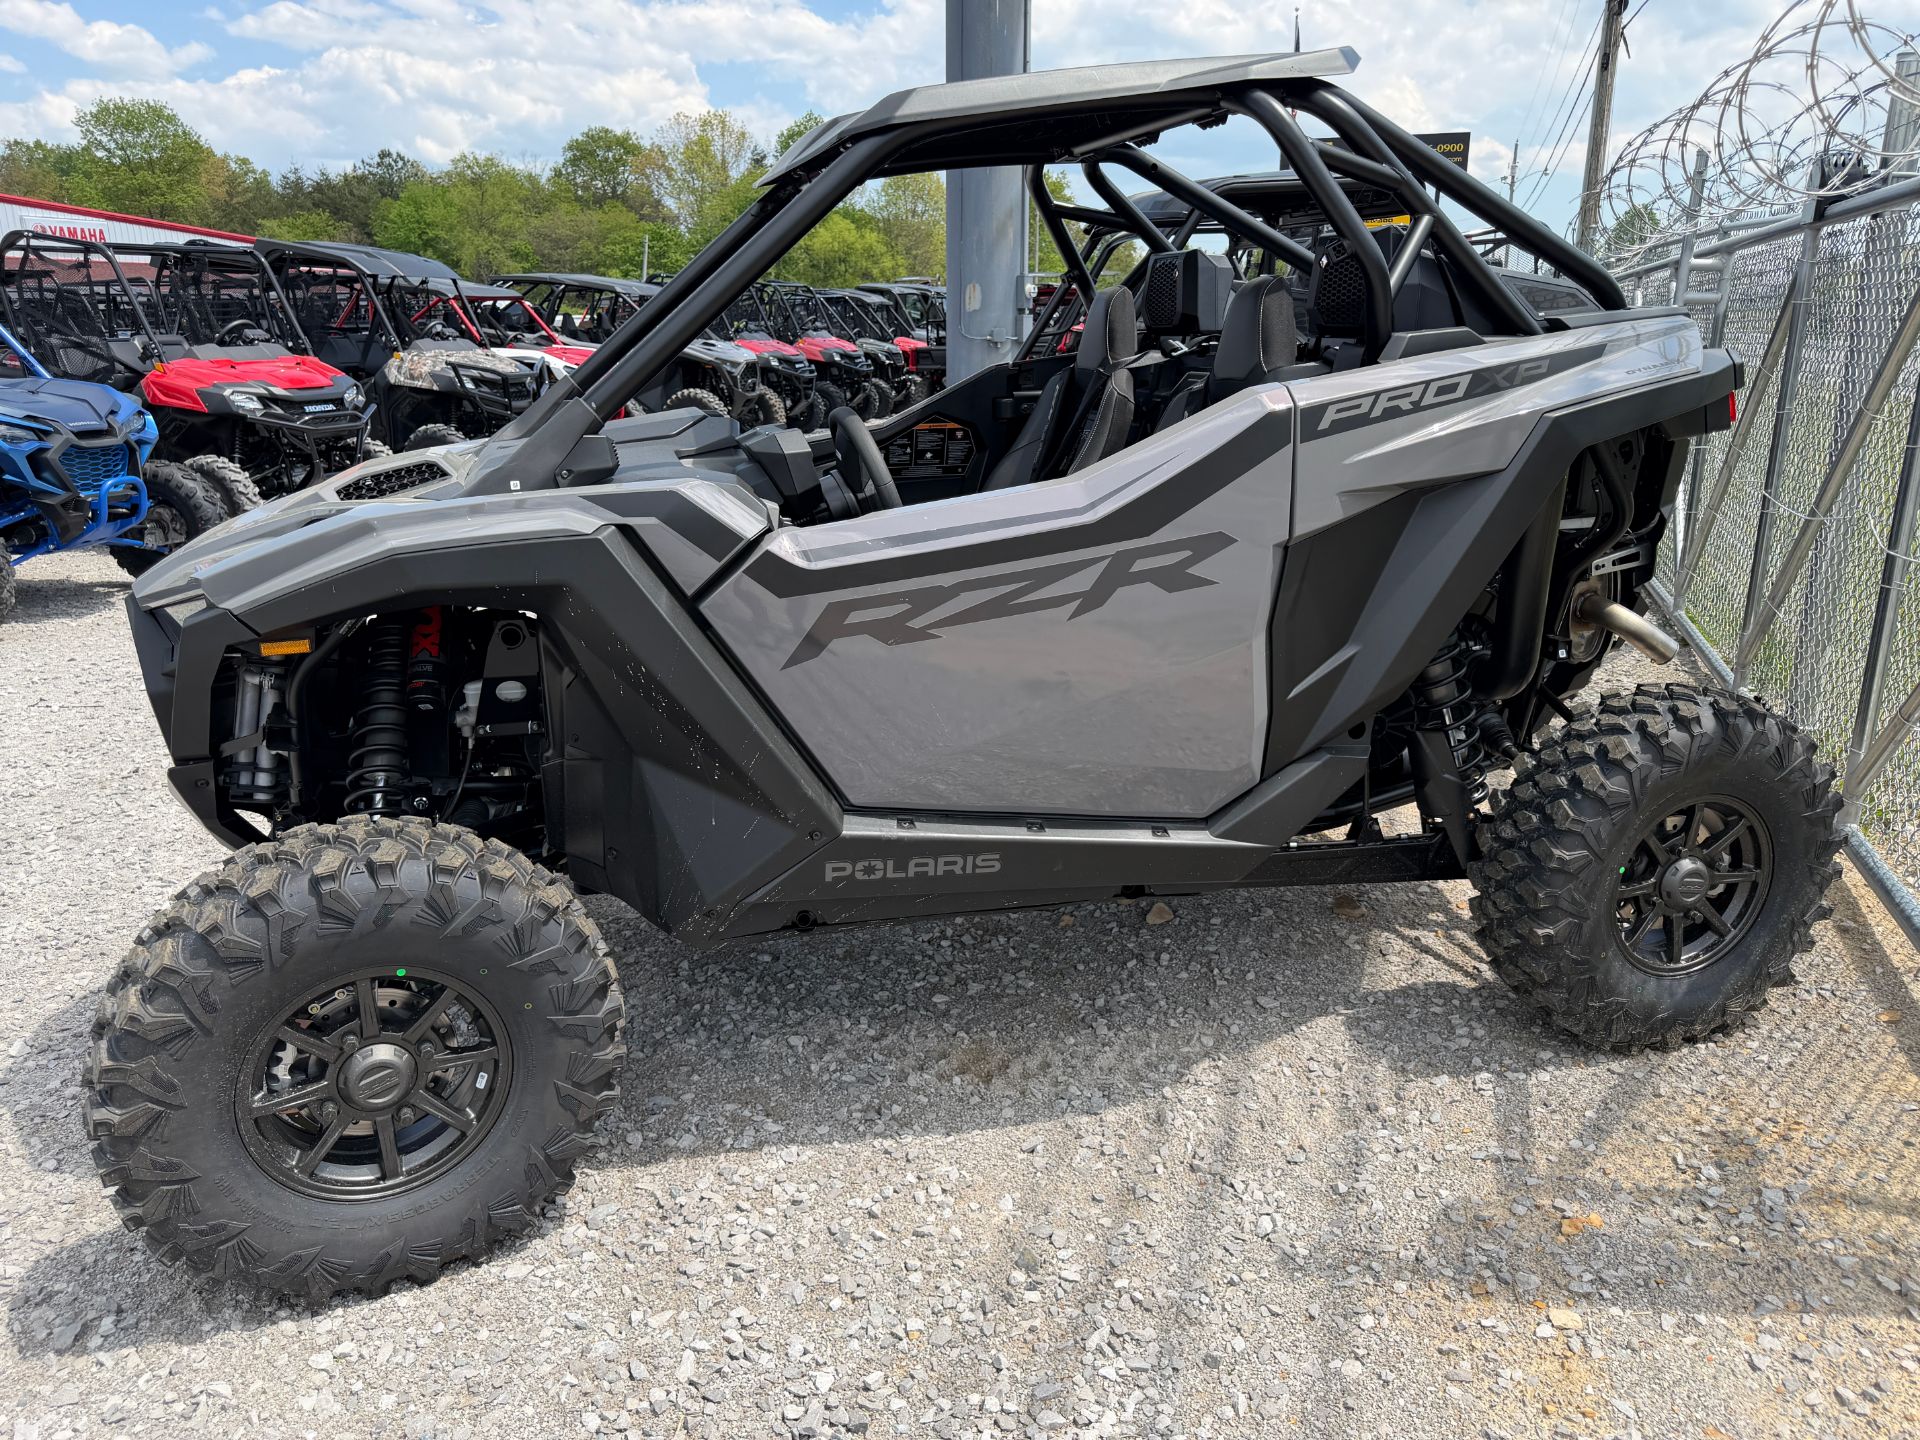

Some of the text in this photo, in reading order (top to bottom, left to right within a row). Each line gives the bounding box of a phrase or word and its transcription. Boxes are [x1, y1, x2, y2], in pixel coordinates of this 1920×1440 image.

[48, 225, 107, 243] YAMAHA
[303, 403, 337, 412] HONDA
[1317, 358, 1550, 431] PRO XP
[779, 530, 1240, 671] RZR
[824, 852, 1002, 882] POLARIS
